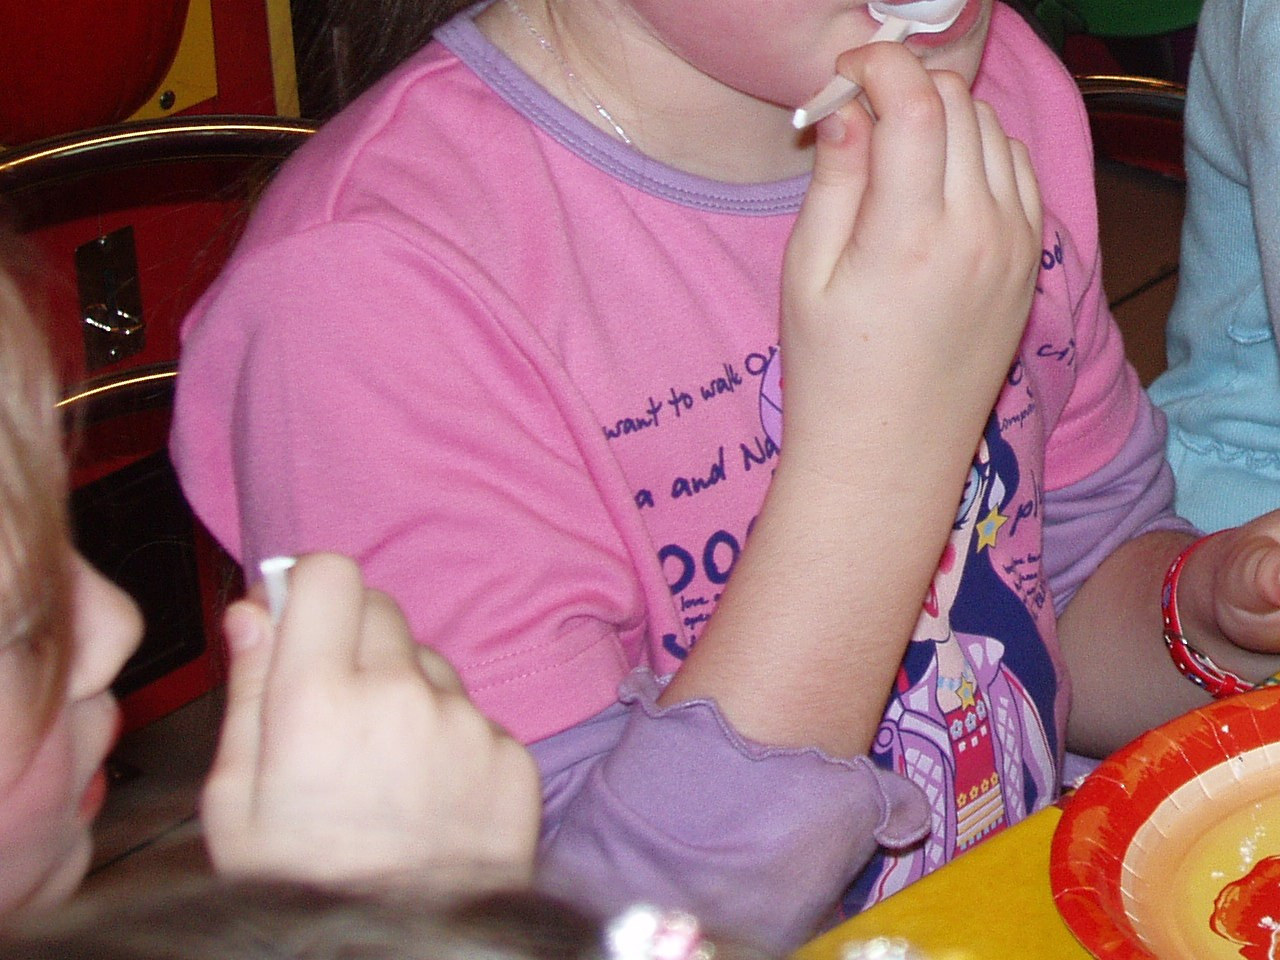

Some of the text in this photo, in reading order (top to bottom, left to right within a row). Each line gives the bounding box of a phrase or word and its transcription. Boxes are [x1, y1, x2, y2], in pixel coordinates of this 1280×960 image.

[602, 397, 662, 440] want
[668, 387, 693, 417] to
[700, 363, 743, 401] walk
[671, 445, 726, 499] and
